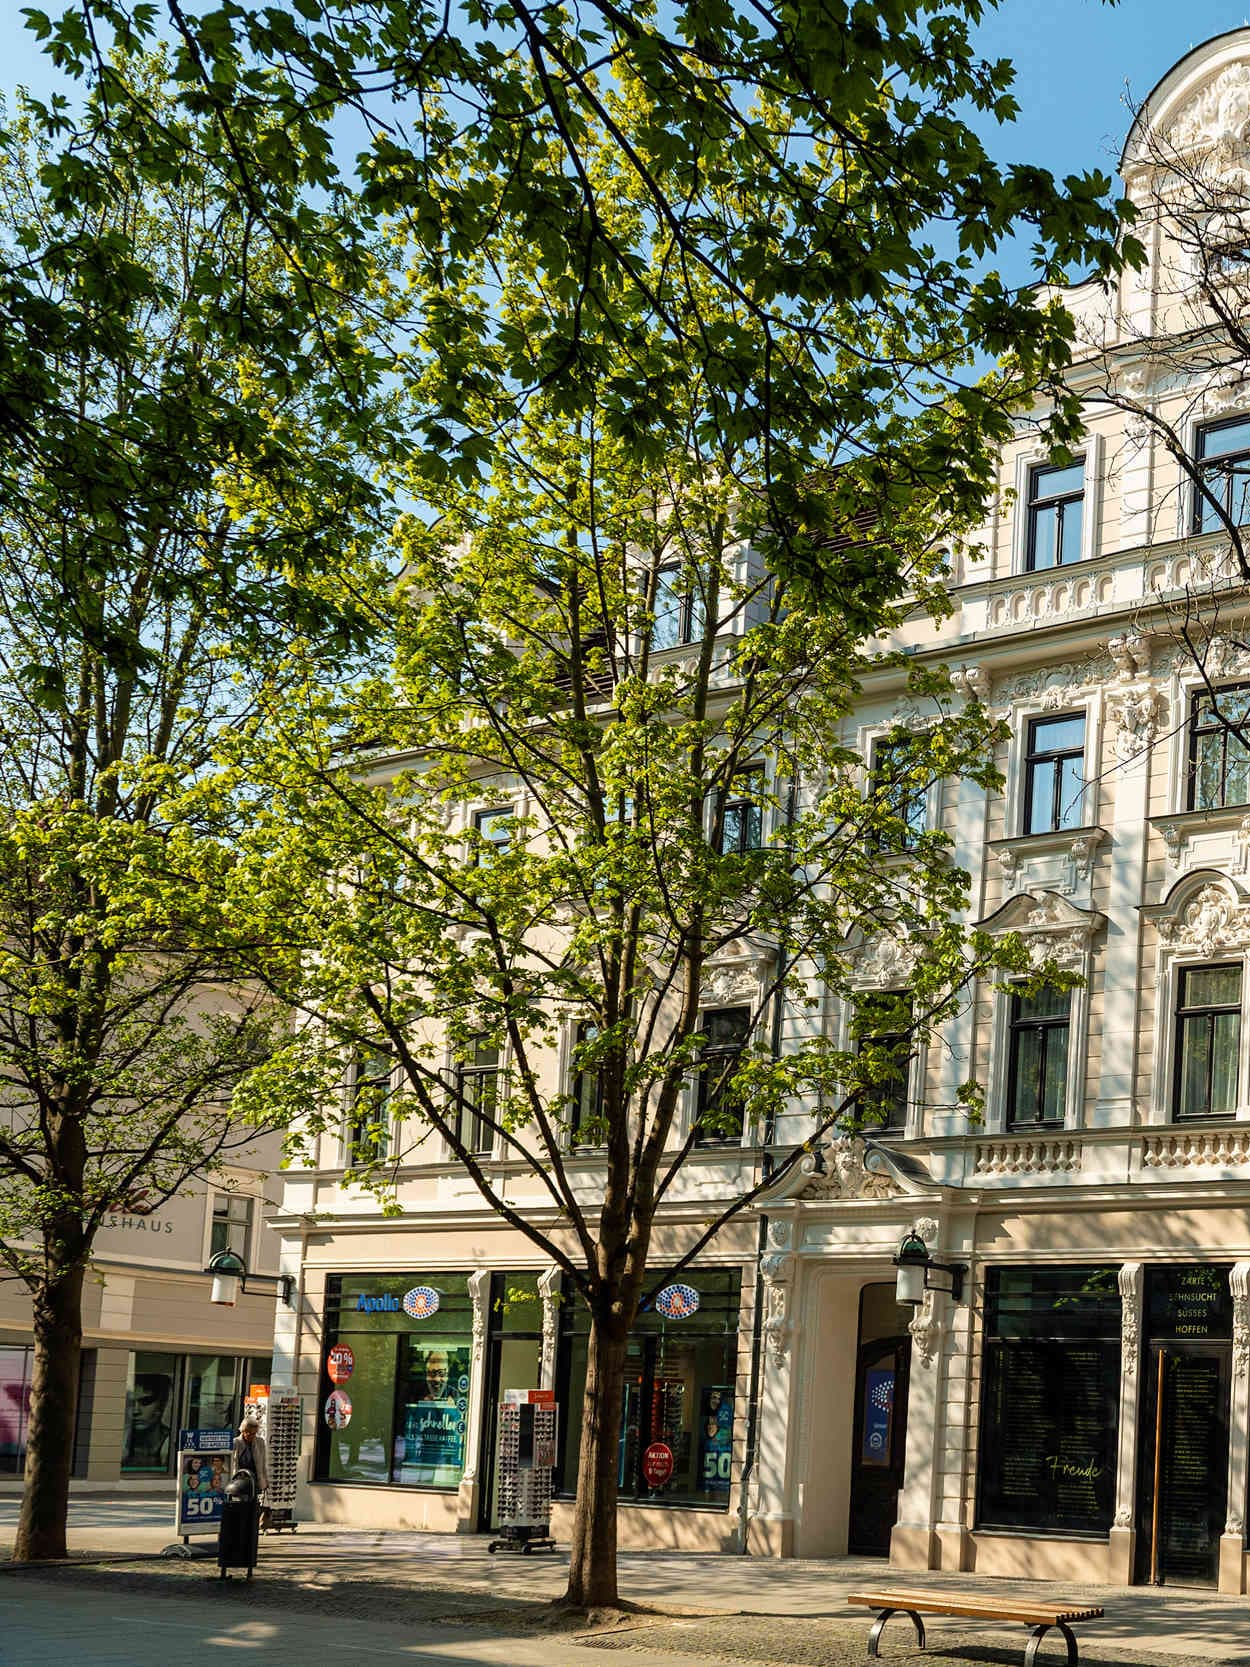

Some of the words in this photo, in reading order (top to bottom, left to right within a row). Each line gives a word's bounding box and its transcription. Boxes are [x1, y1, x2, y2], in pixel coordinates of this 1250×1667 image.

[356, 1293, 399, 1316] Apollo
[1176, 1325, 1208, 1334] HOFFEN
[703, 1452, 731, 1479] 50
[1045, 1456, 1104, 1481] Freude
